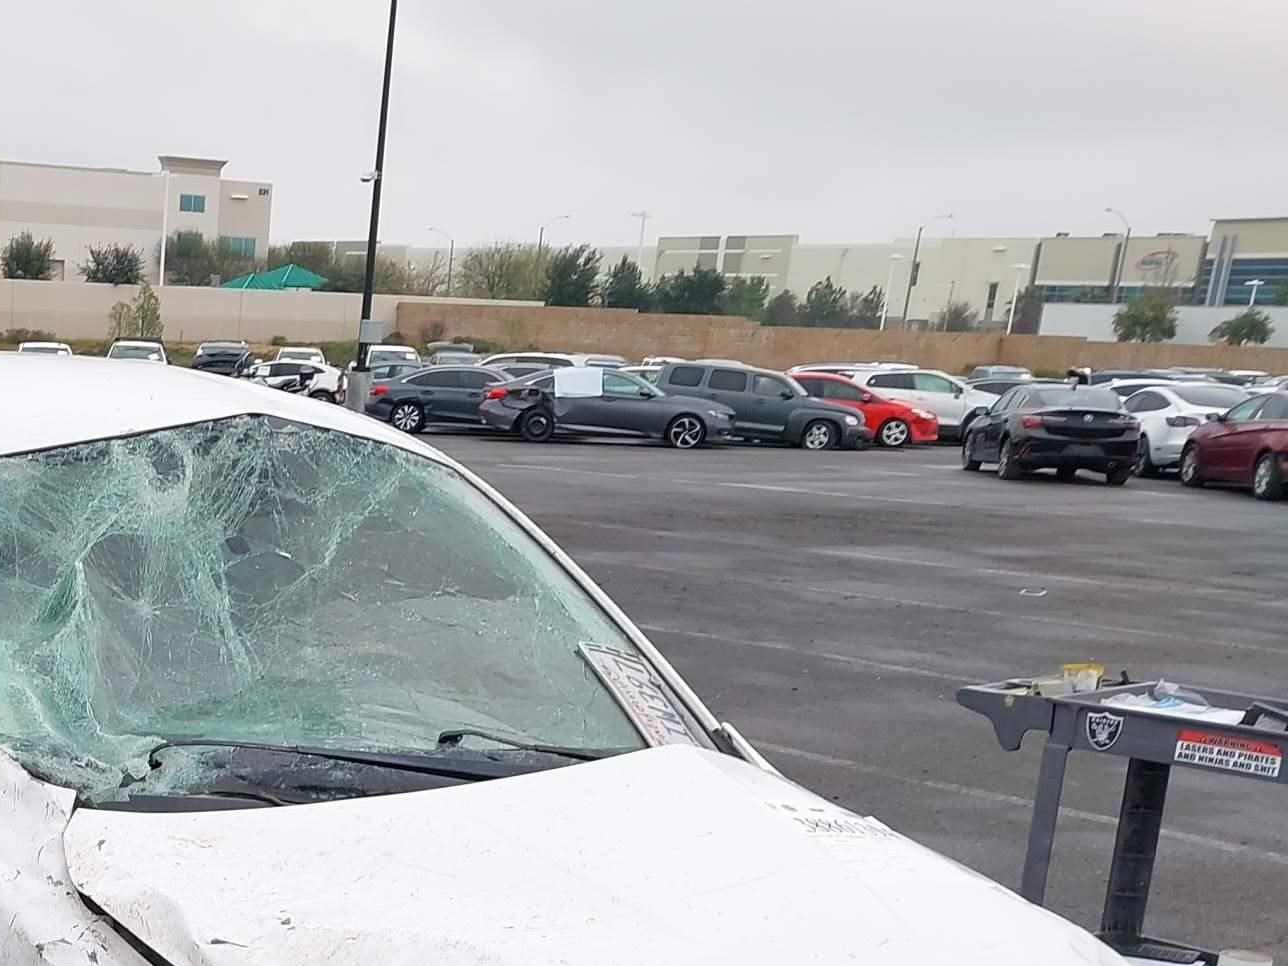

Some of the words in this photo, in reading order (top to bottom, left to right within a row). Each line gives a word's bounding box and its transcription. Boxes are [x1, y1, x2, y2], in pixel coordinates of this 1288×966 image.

[1177, 751, 1196, 762] AND
[1197, 754, 1231, 768] NINJAS
[1232, 760, 1253, 771] AND
[1253, 764, 1278, 776] SHIT
[1180, 742, 1214, 756] LASERS
[1215, 748, 1236, 759] AND
[1237, 751, 1277, 766] PIRATES
